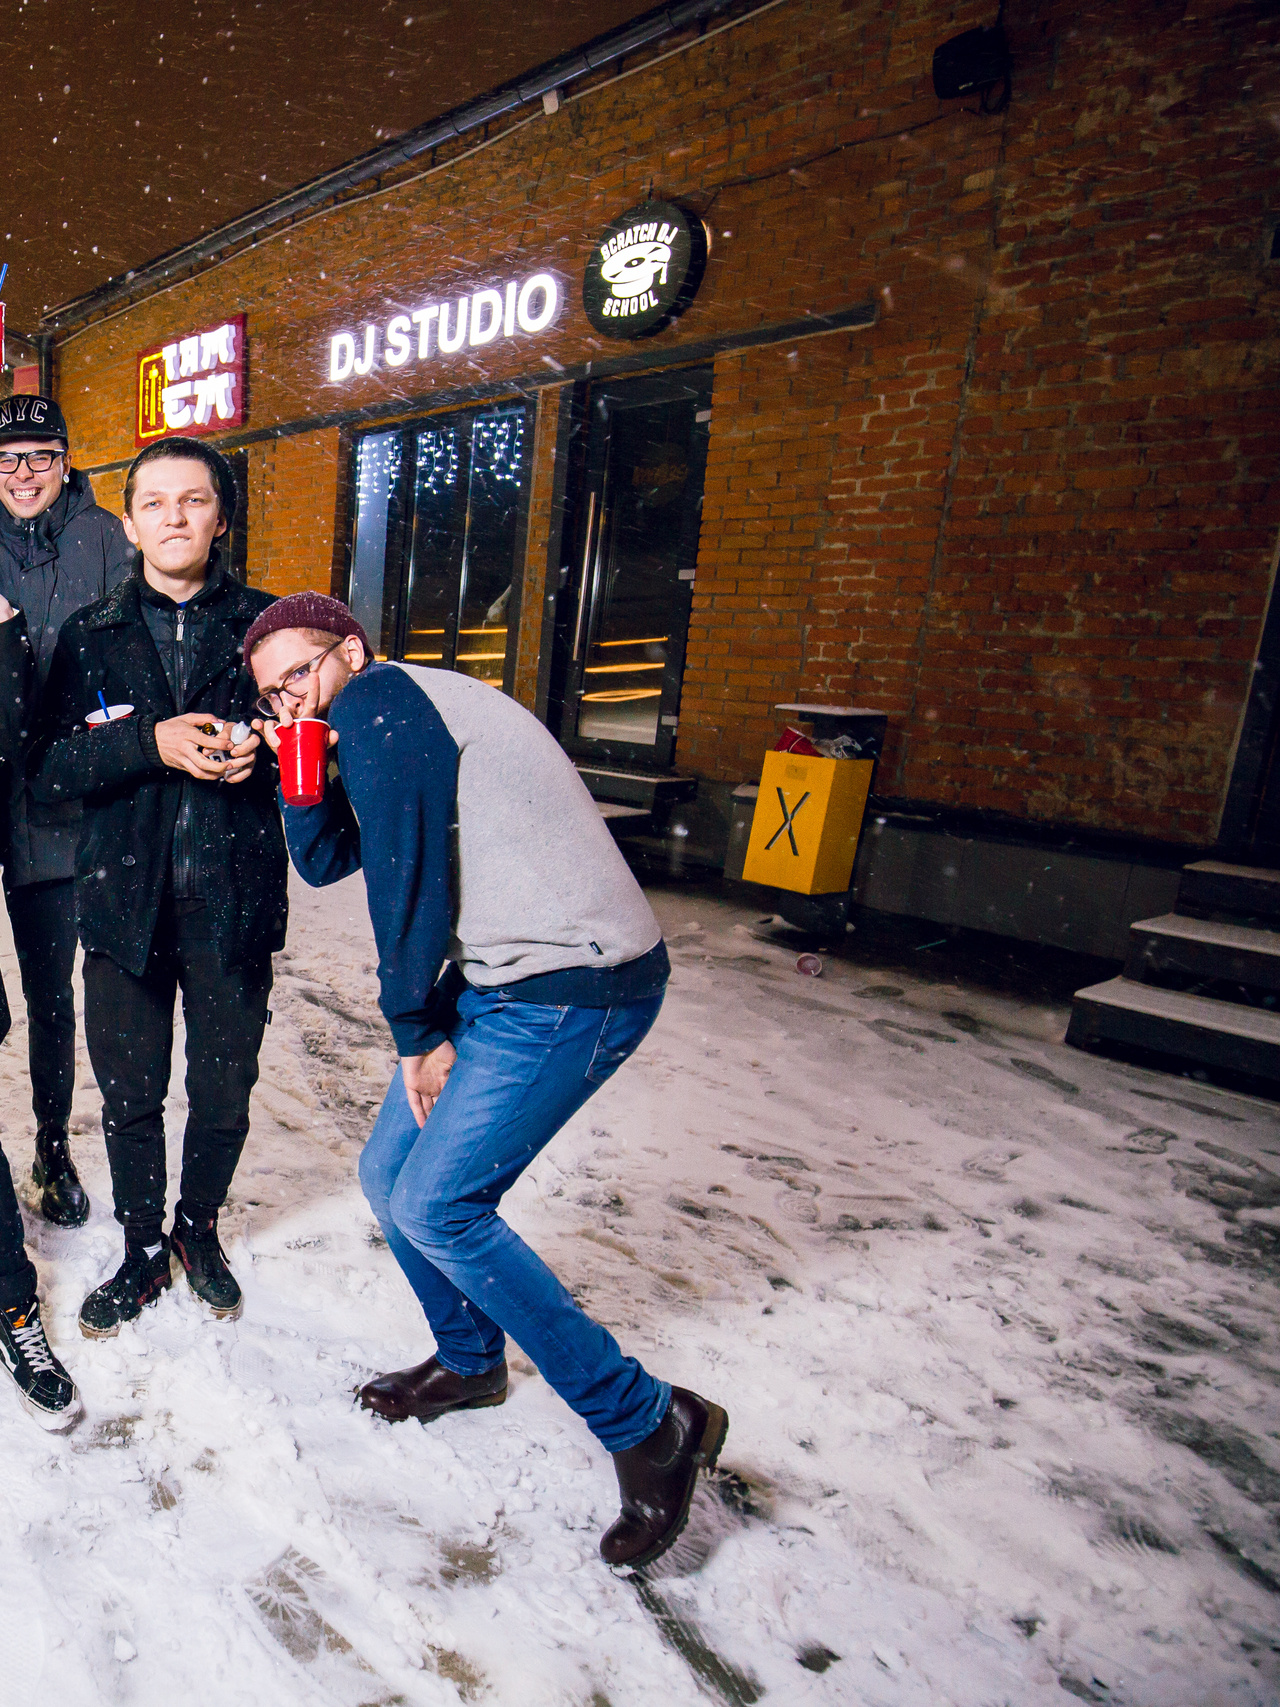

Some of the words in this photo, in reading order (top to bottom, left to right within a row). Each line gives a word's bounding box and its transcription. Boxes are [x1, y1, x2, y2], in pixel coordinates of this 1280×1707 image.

[600, 222, 658, 261] SCRATCH
[656, 223, 679, 245] DJ
[602, 290, 659, 317] SCHOOL
[329, 324, 375, 382] DJ
[384, 273, 558, 367] STUDIO
